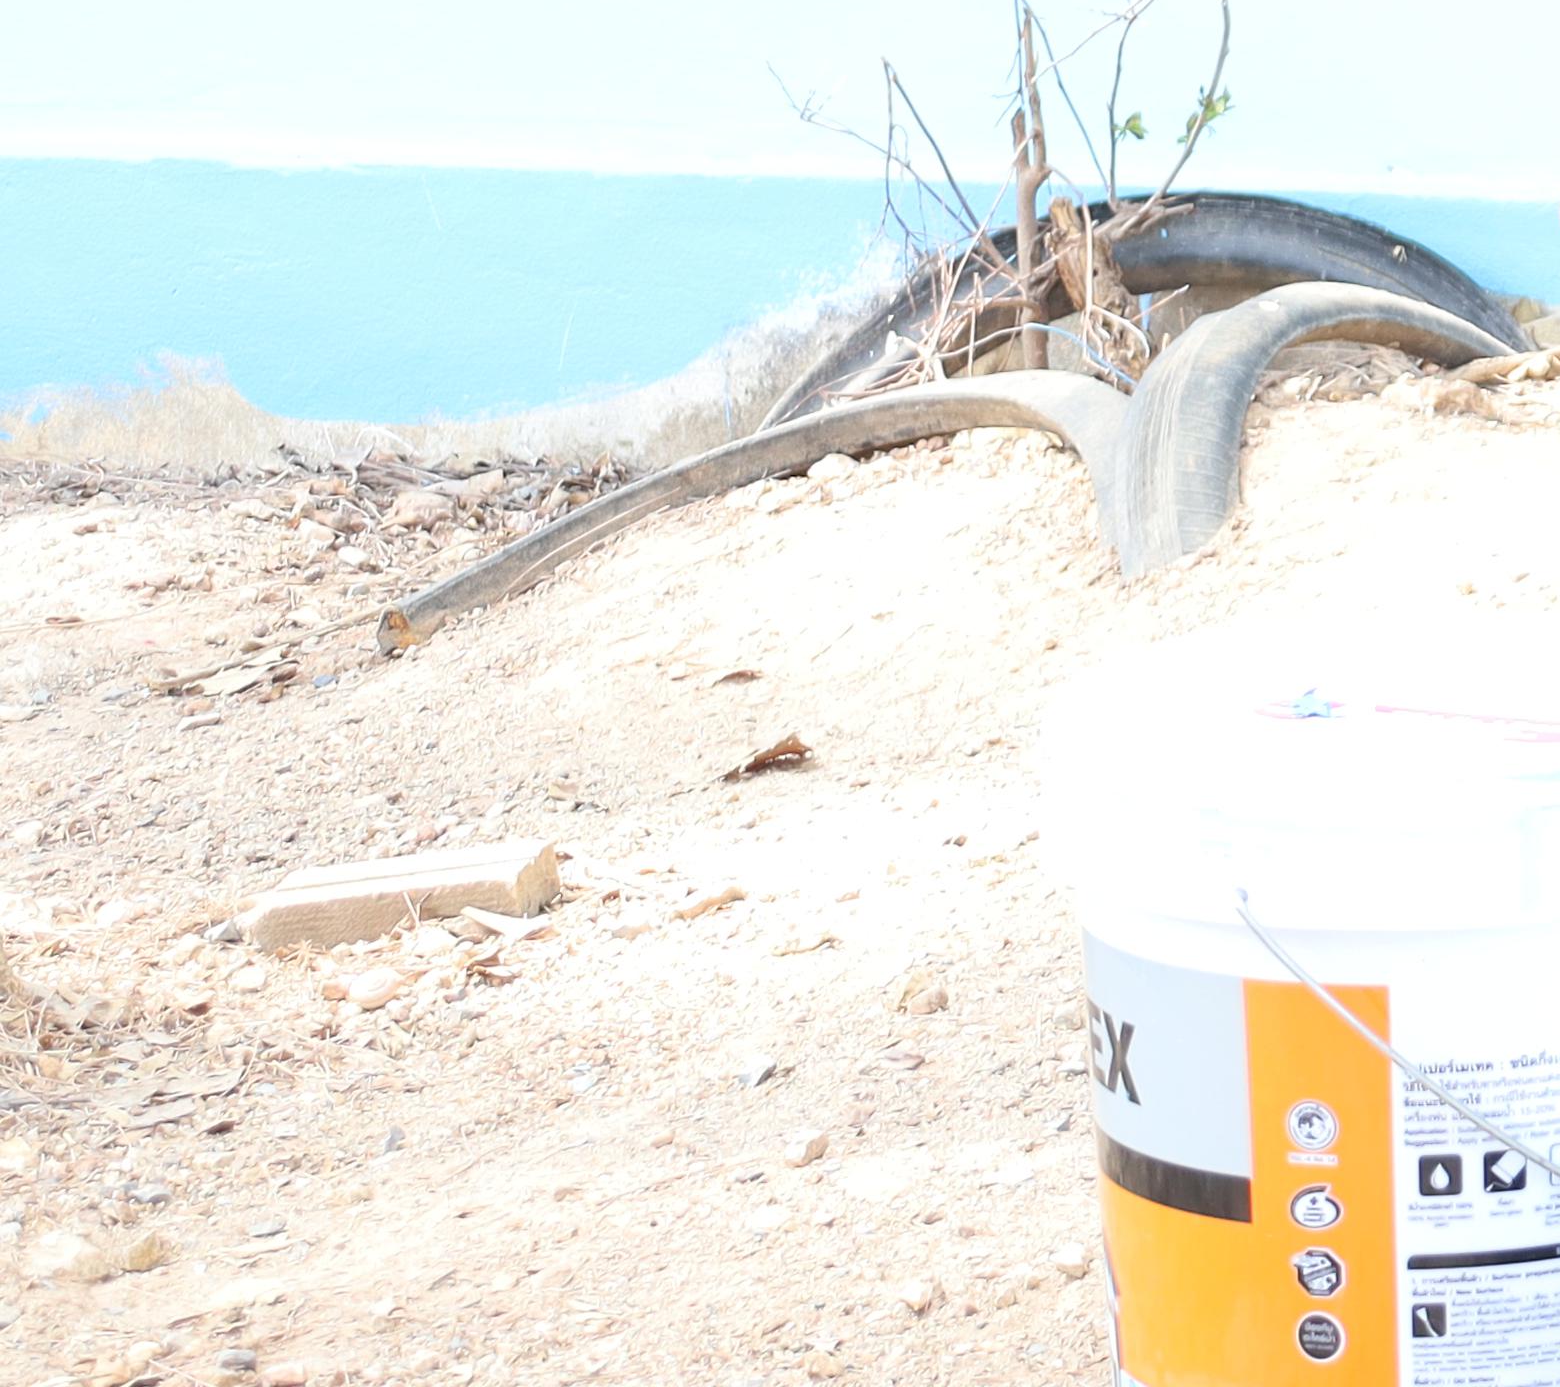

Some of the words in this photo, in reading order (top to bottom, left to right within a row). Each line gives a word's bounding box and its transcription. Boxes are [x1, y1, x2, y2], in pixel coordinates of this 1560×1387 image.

[1403, 1057, 1495, 1080] ุปเปอร์เมเทค
